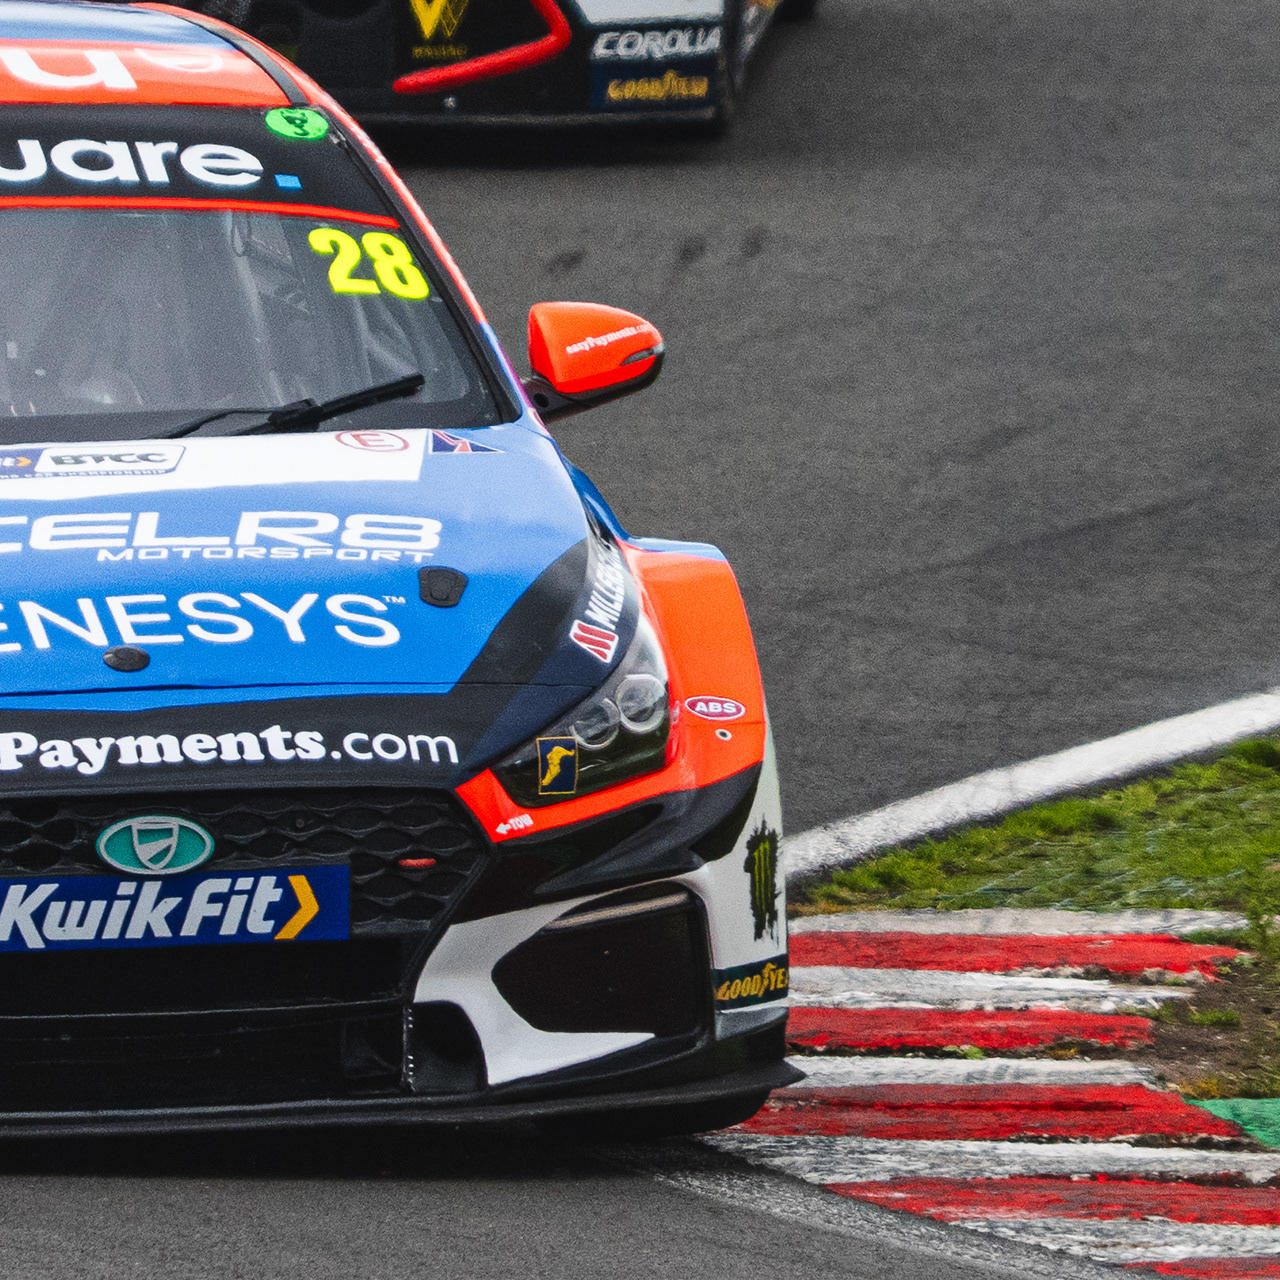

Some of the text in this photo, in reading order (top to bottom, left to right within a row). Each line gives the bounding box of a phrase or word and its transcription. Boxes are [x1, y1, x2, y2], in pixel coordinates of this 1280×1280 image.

[593, 26, 720, 60] COROLLA
[308, 227, 430, 299] 28
[49, 452, 170, 466] BTCC
[97, 544, 436, 564] MOTORSPORT
[694, 701, 737, 714] ABS
[508, 813, 534, 830] TOW
[714, 962, 789, 1001] GOODYE
